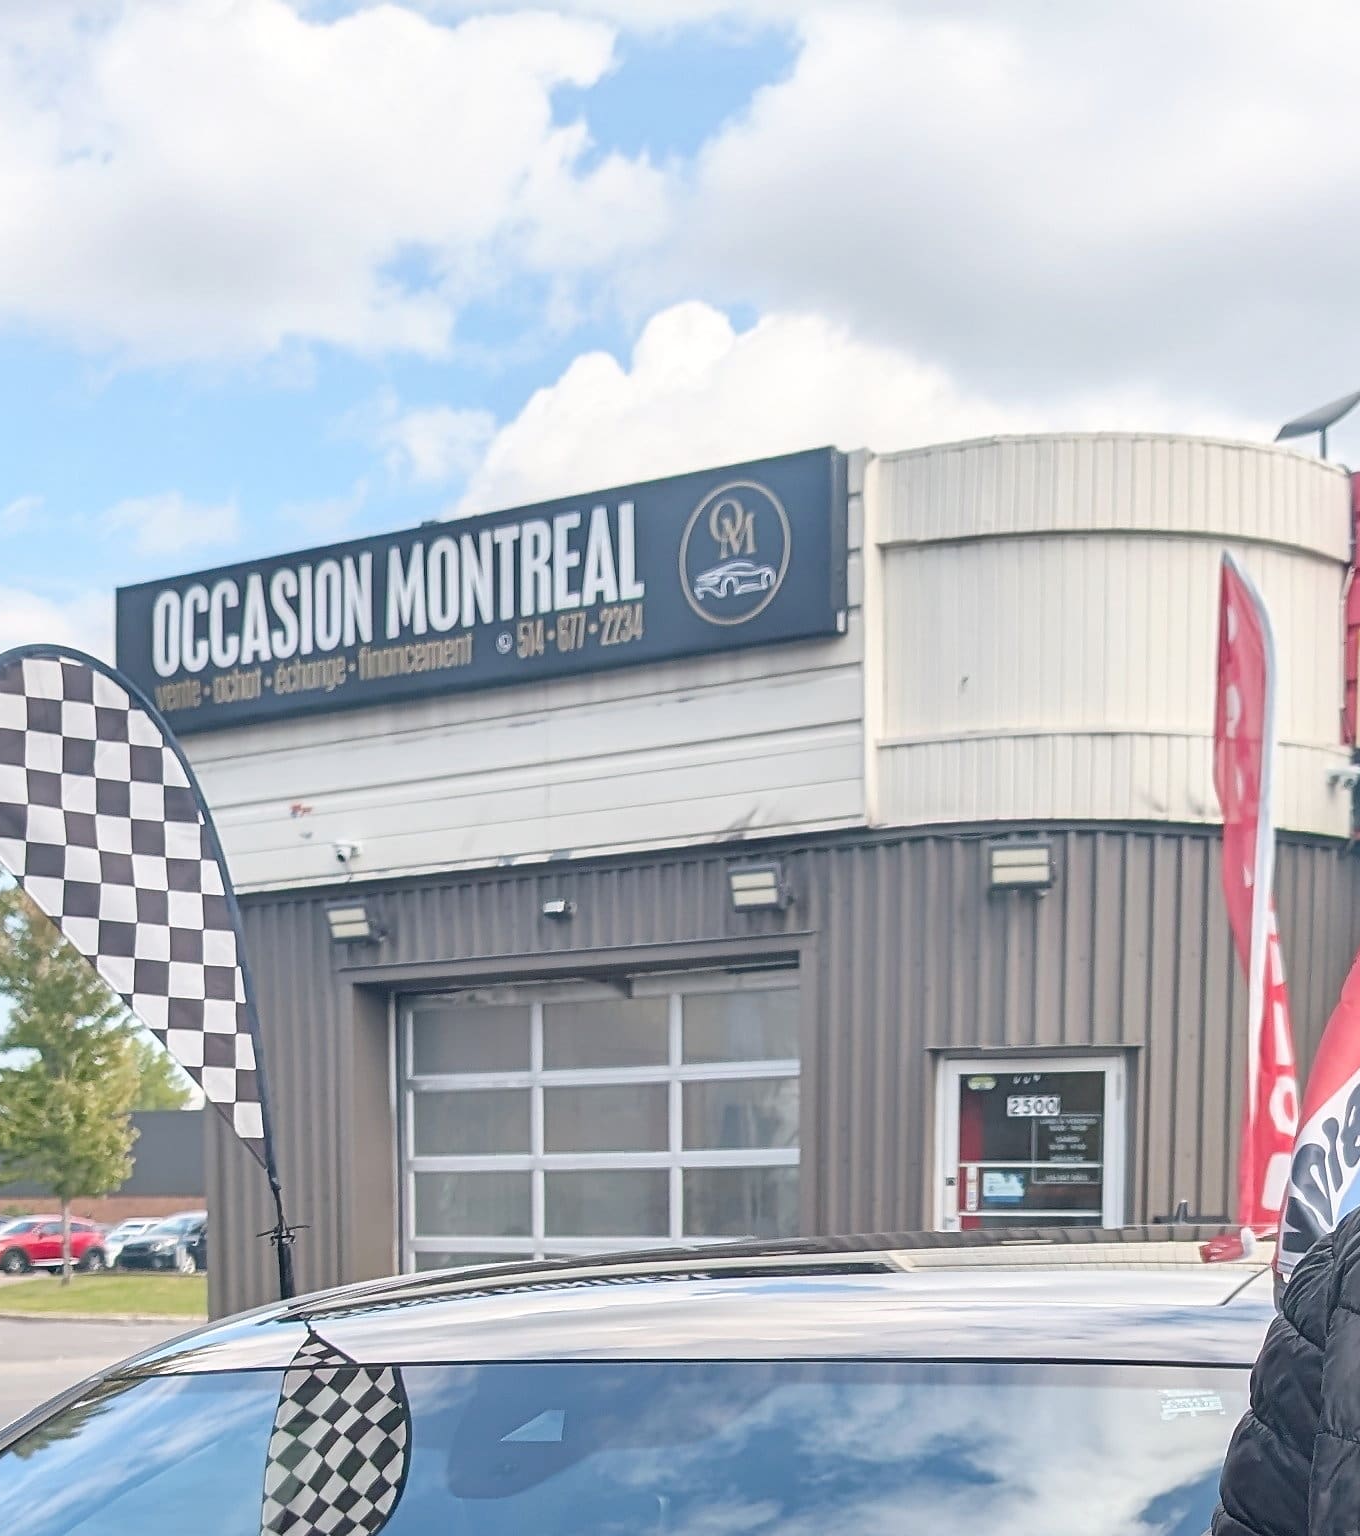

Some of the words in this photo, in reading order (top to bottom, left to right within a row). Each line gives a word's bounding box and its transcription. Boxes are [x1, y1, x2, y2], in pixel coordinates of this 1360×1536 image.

[152, 550, 373, 678] OCCASION
[386, 501, 645, 640] MONTREAL
[358, 633, 473, 681] financement
[1009, 1098, 1057, 1115] 2500
